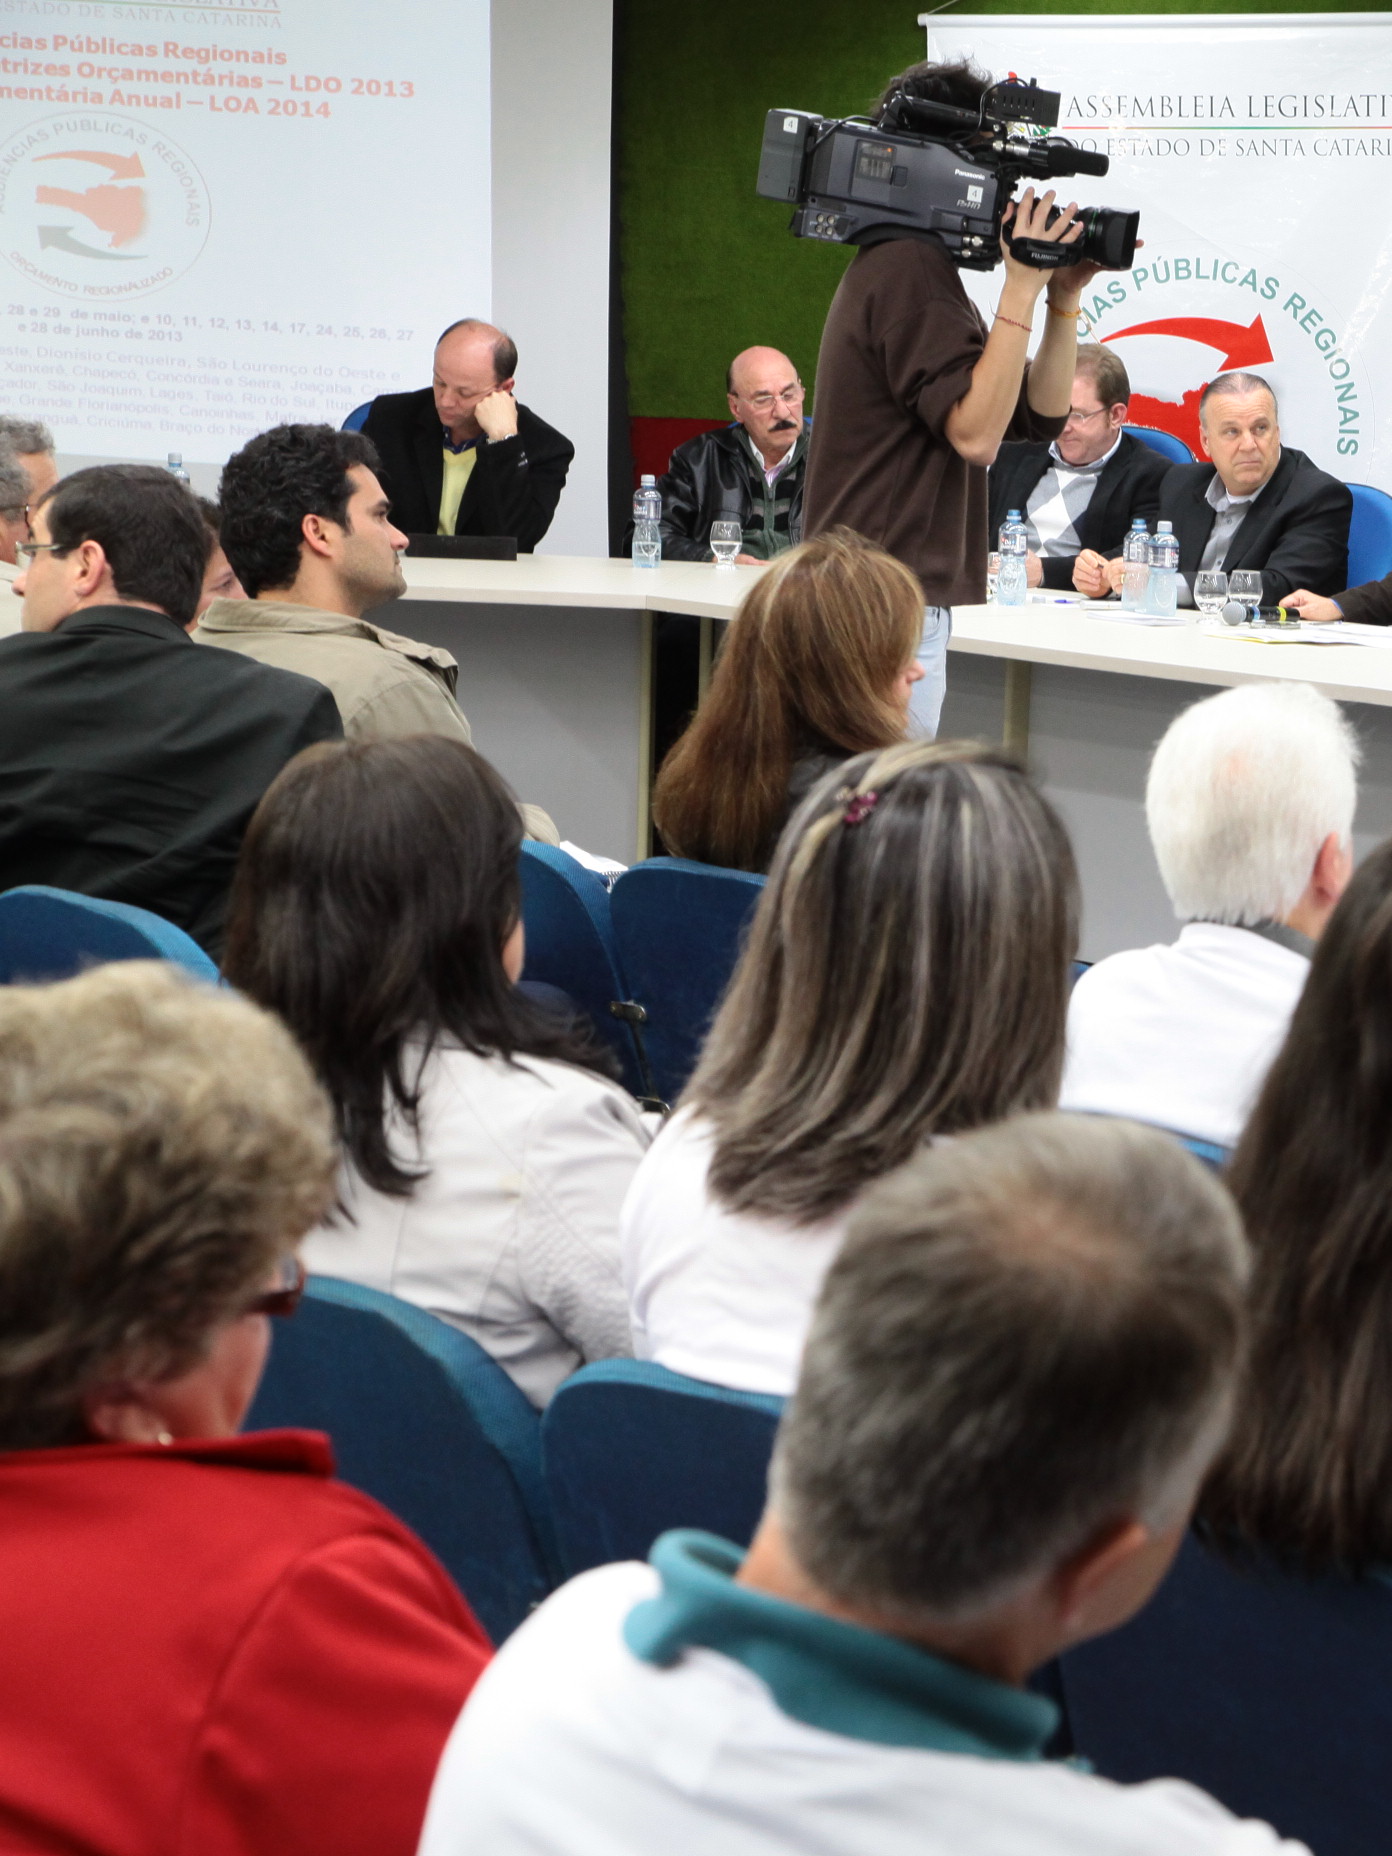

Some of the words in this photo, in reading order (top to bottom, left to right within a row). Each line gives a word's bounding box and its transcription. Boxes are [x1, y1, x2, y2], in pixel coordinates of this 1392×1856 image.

[0, 2, 71, 16] STADO
[79, 5, 104, 18] DE
[112, 7, 176, 22] SANTA
[183, 12, 282, 29] CATARINA
[53, 34, 158, 57] Públicas
[163, 41, 288, 66] Regionais
[1, 57, 71, 77] trizes
[77, 61, 263, 89] Orçamentárias
[290, 74, 342, 94] LDO
[351, 78, 415, 98] 2013
[109, 88, 182, 110] Anual
[209, 95, 260, 114] LOA
[267, 98, 332, 118] 2014
[1066, 95, 1236, 119] ASSEMBLEIA
[1107, 138, 1191, 157] ESTADO
[1200, 138, 1227, 157] DE
[1235, 138, 1306, 157] SANTA
[152, 141, 201, 227] REGIONAIS
[954, 168, 986, 181] Panasonic
[7, 304, 24, 316] 28
[29, 307, 38, 317] e
[43, 306, 61, 318] 29
[70, 308, 89, 320] de
[140, 314, 150, 324] e
[155, 314, 176, 328] 10,
[183, 315, 202, 329] 11,
[209, 317, 229, 330] 12,
[235, 319, 256, 333] 13,
[262, 321, 283, 334] 14,
[289, 322, 310, 336] 17,
[316, 324, 337, 338] 24,
[396, 329, 414, 341] 27
[18, 323, 27, 332] e
[30, 321, 48, 333] 28
[53, 323, 71, 335] de
[75, 324, 120, 338] junho
[124, 327, 143, 339] de
[148, 329, 183, 342] 2013
[196, 355, 227, 370] São
[232, 359, 308, 377] Lourenço
[313, 364, 334, 377] do
[338, 366, 387, 380] Oeste
[1132, 256, 1280, 301] PÚBLICAS
[1282, 292, 1360, 457] REGIONAIS
[242, 393, 266, 406] Rio
[270, 394, 288, 407] do
